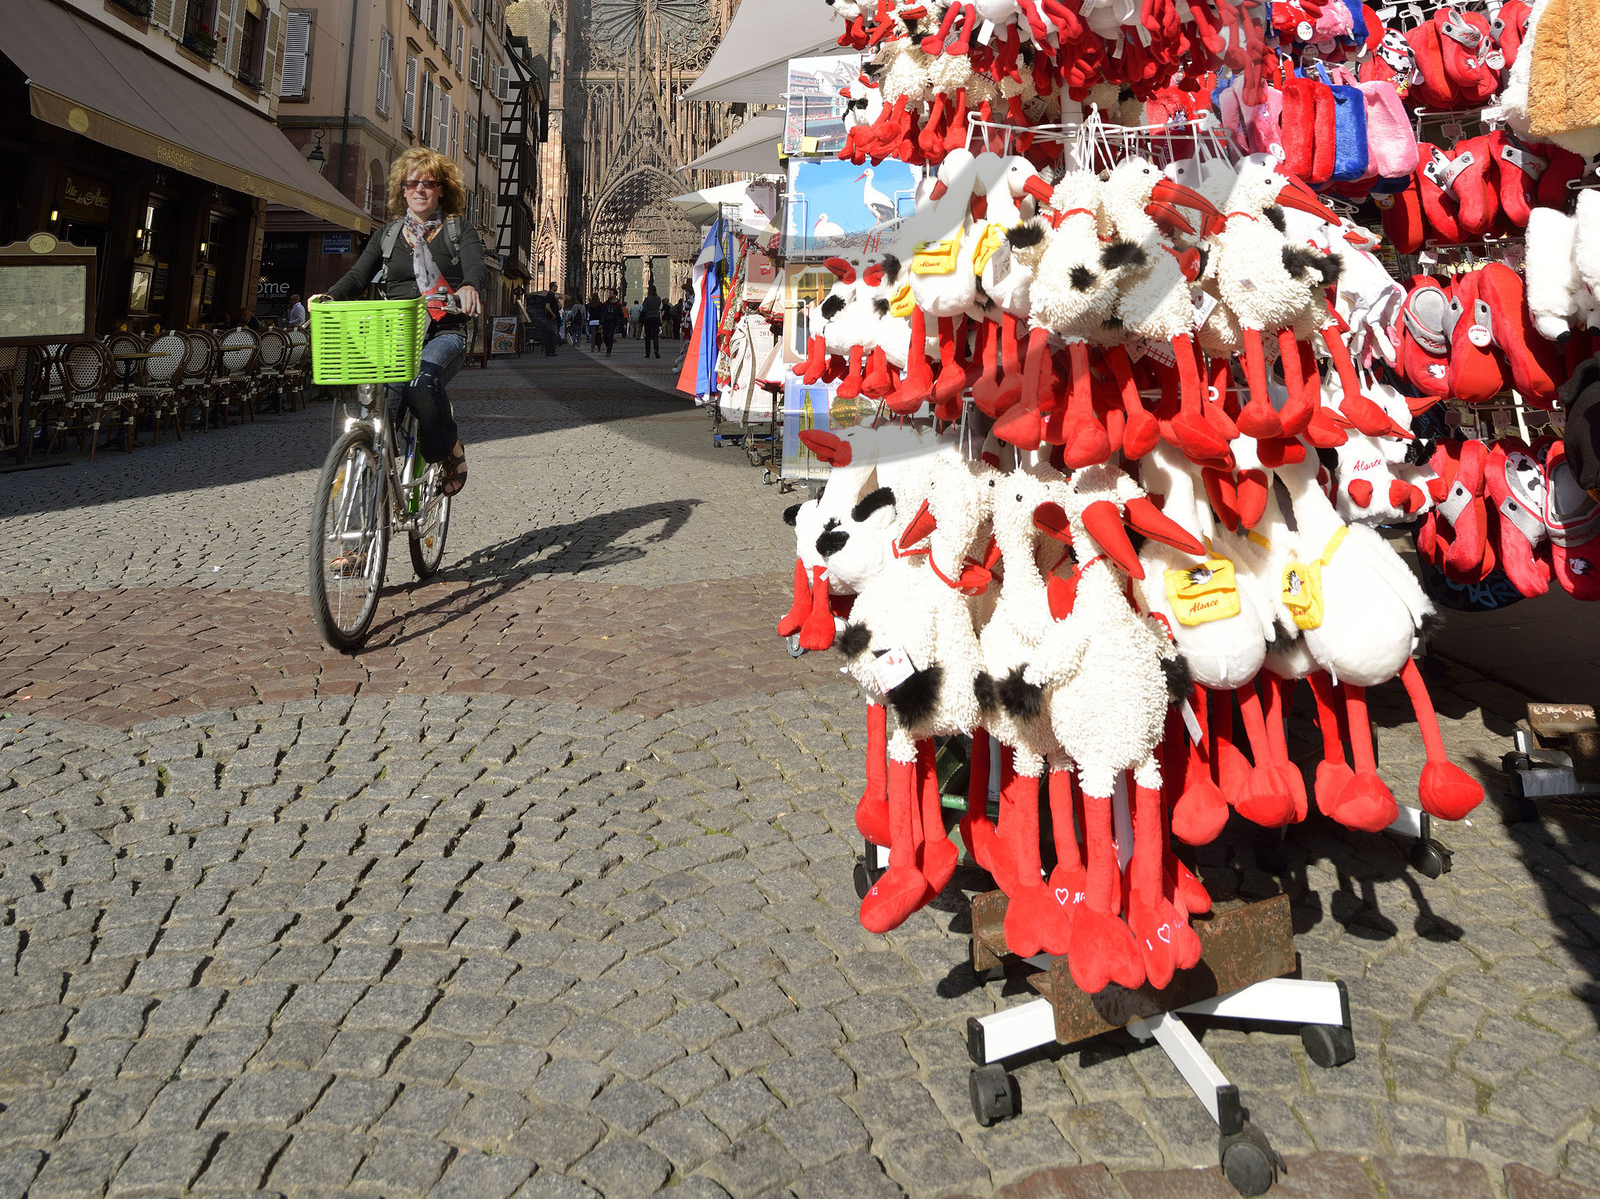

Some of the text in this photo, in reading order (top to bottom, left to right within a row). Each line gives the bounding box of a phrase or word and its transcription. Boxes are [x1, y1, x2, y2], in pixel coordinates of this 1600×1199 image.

[157, 145, 195, 171] BRASSERIE
[919, 260, 941, 268] Alsace
[1353, 458, 1383, 473] Alsace
[1188, 599, 1219, 617] Alsace
